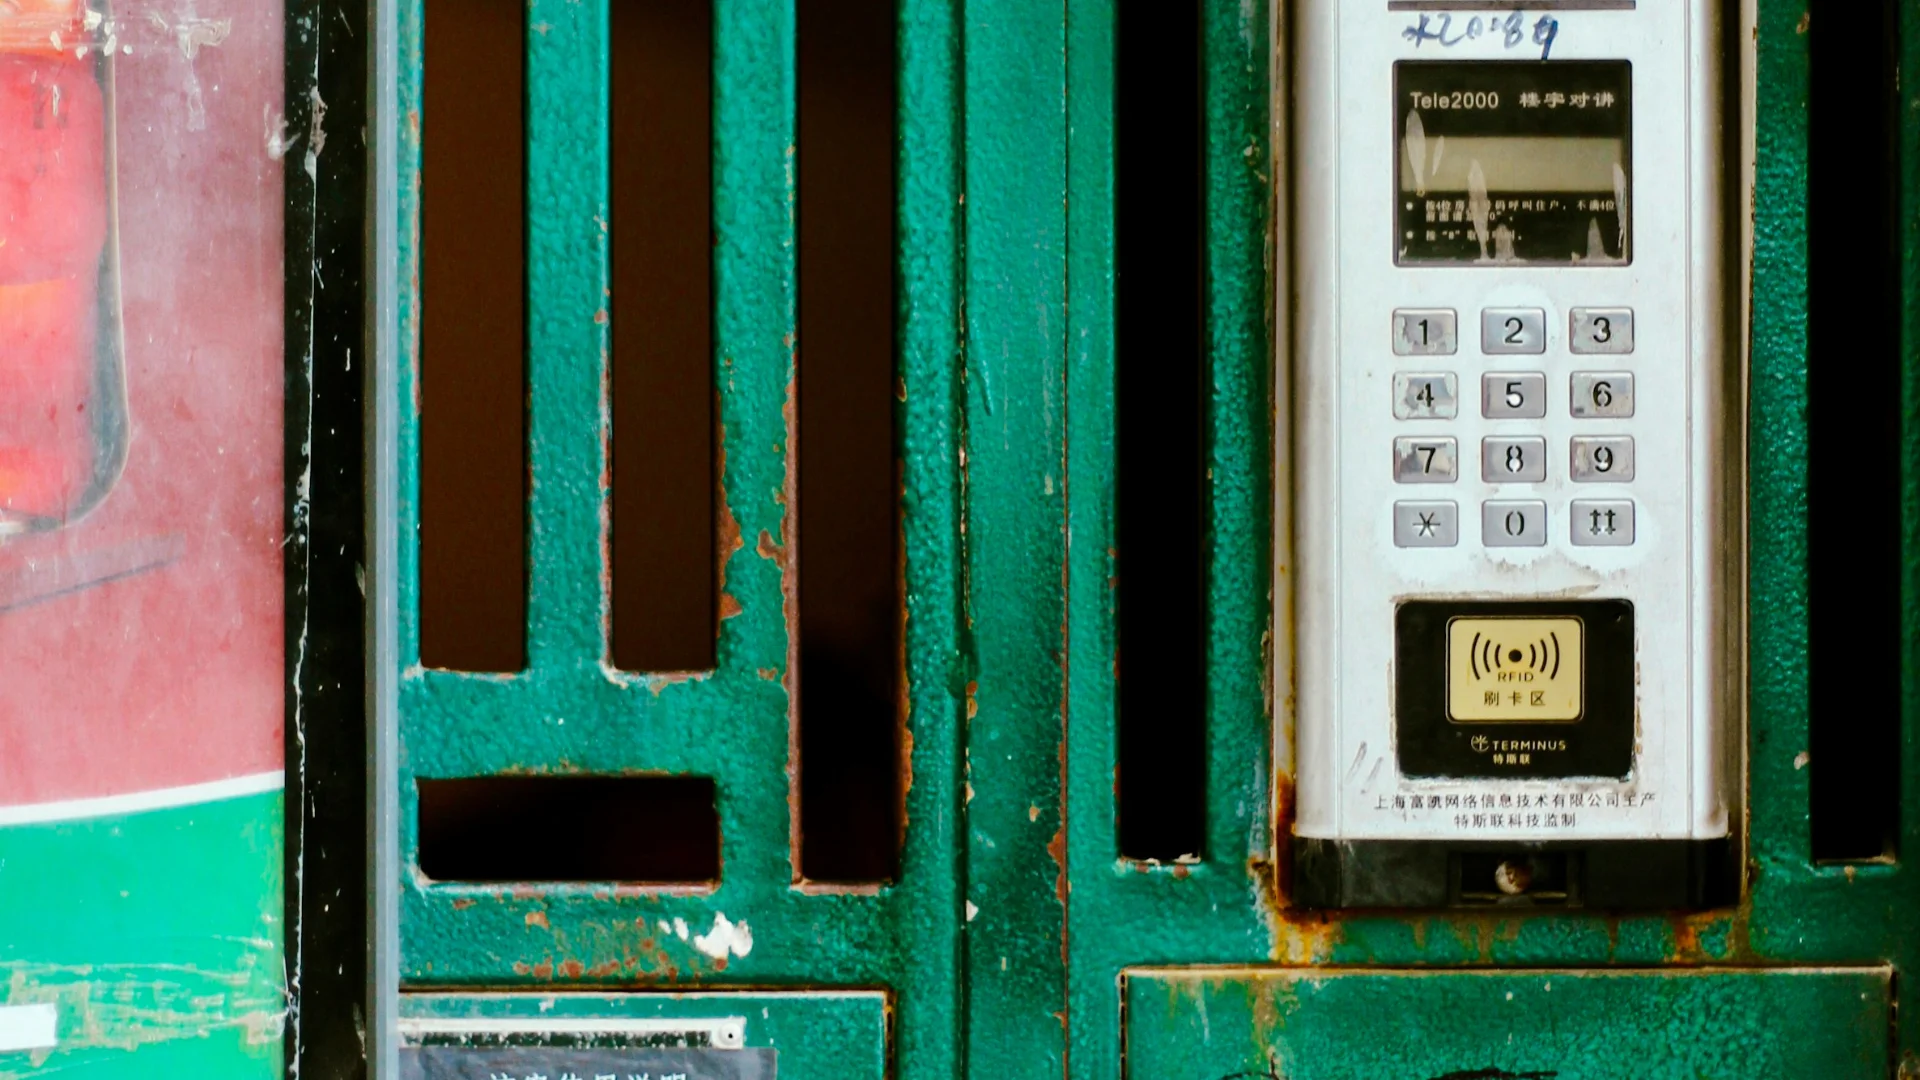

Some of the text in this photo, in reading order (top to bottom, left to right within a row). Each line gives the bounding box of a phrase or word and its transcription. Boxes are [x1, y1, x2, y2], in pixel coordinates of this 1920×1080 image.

[1410, 91, 1499, 109] Tele2000
[1519, 91, 1615, 109] 楼宇对讲
[1418, 316, 1612, 346] 1 2 3
[1416, 380, 1613, 409] 4 5 6
[1417, 445, 1614, 474] 7 8 9
[1505, 510, 1526, 537] 0
[1498, 671, 1534, 683] RFID
[1483, 690, 1546, 707] 刷卡区
[1492, 739, 1567, 752] TERMINUS
[1493, 753, 1531, 765] 特斯联
[1453, 812, 1577, 829] 特斯联科技监制
